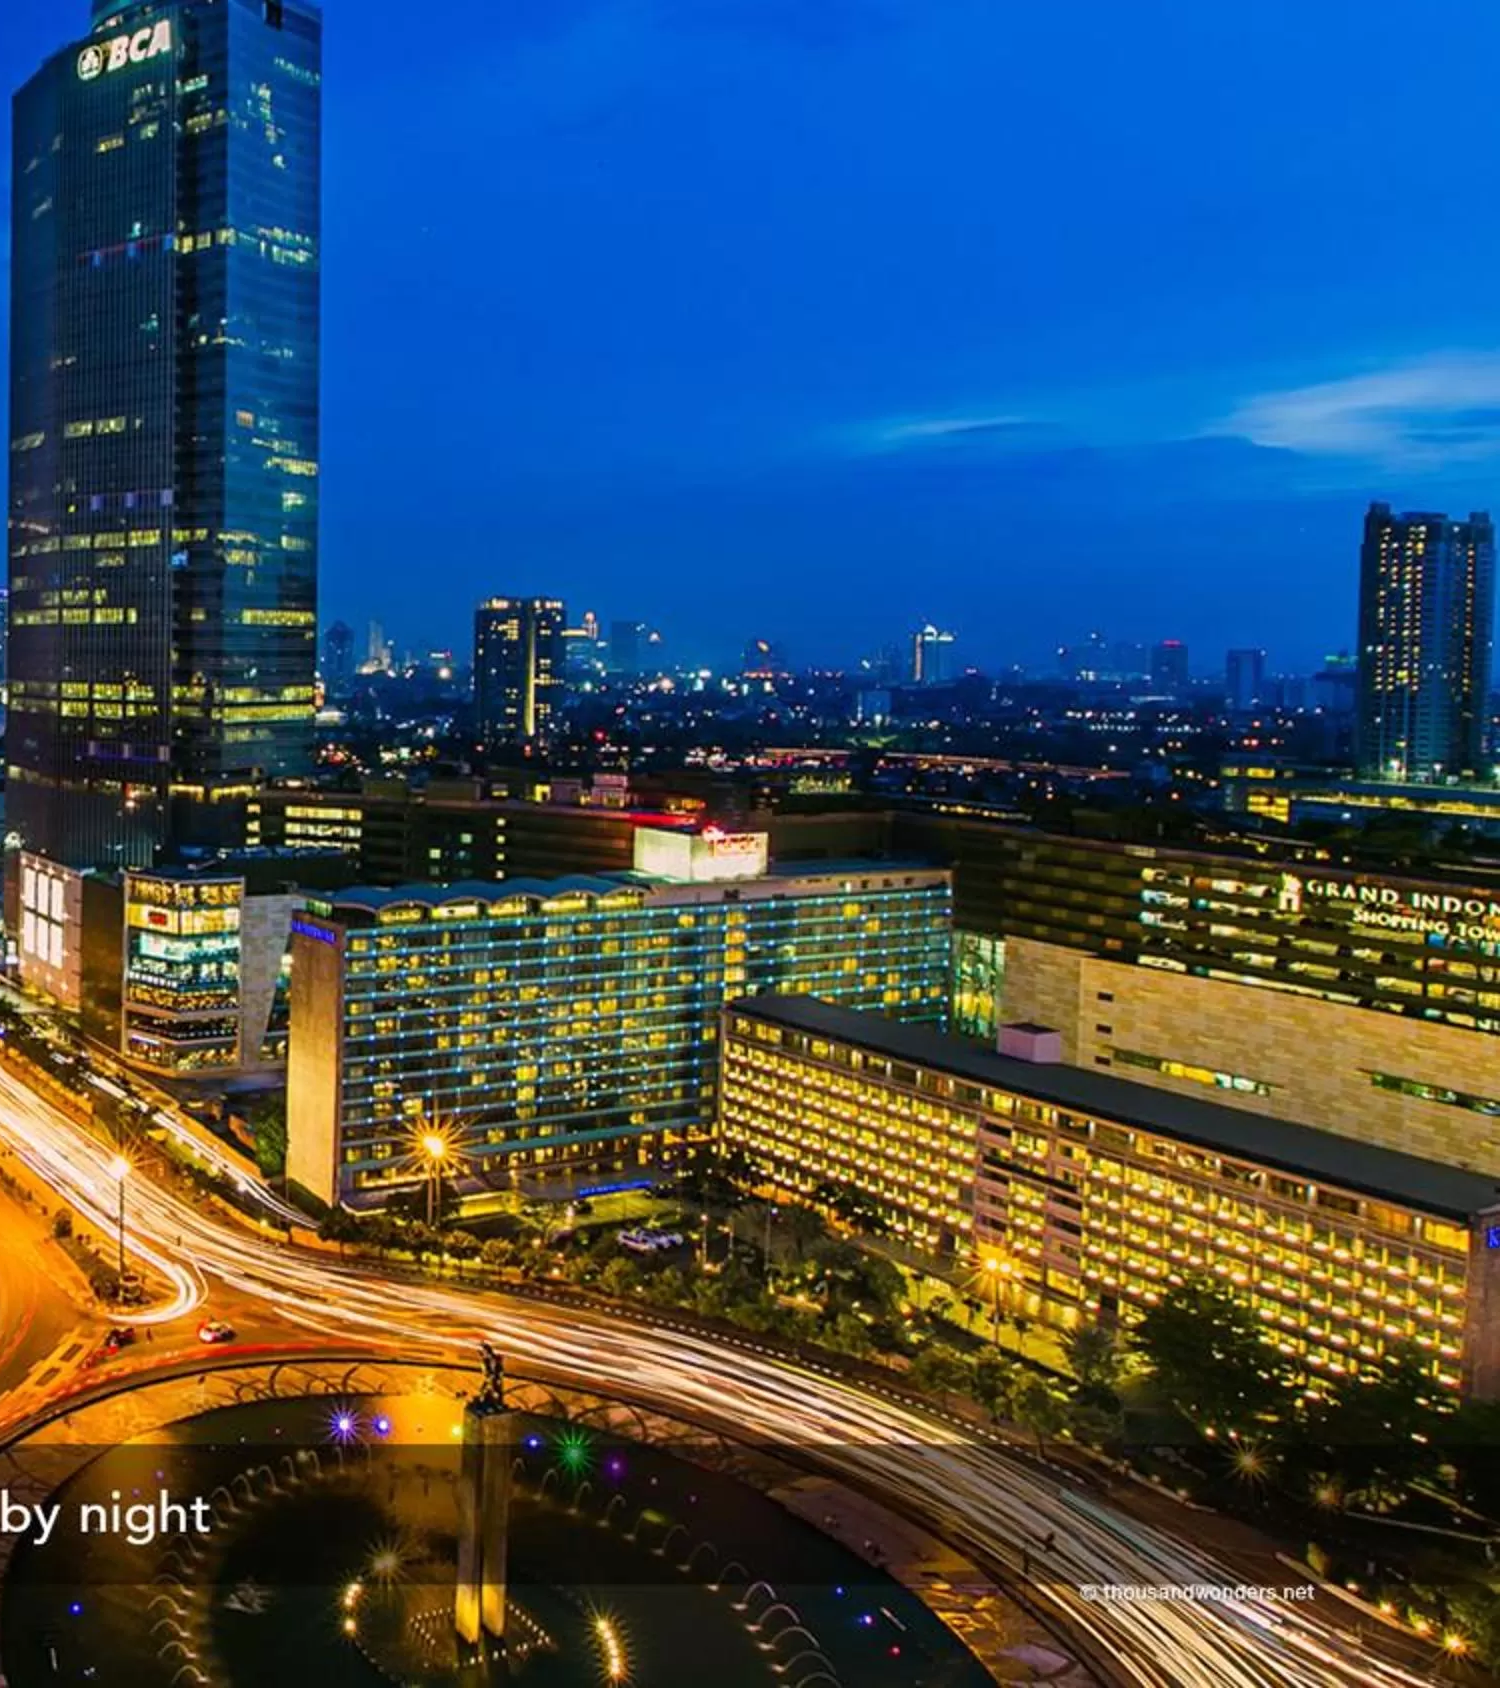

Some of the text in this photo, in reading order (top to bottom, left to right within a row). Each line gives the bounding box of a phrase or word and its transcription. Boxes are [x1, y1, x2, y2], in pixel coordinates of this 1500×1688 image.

[108, 19, 171, 72] BCA
[1307, 879, 1399, 904] GRAND
[1353, 907, 1449, 934] SHOPPING
